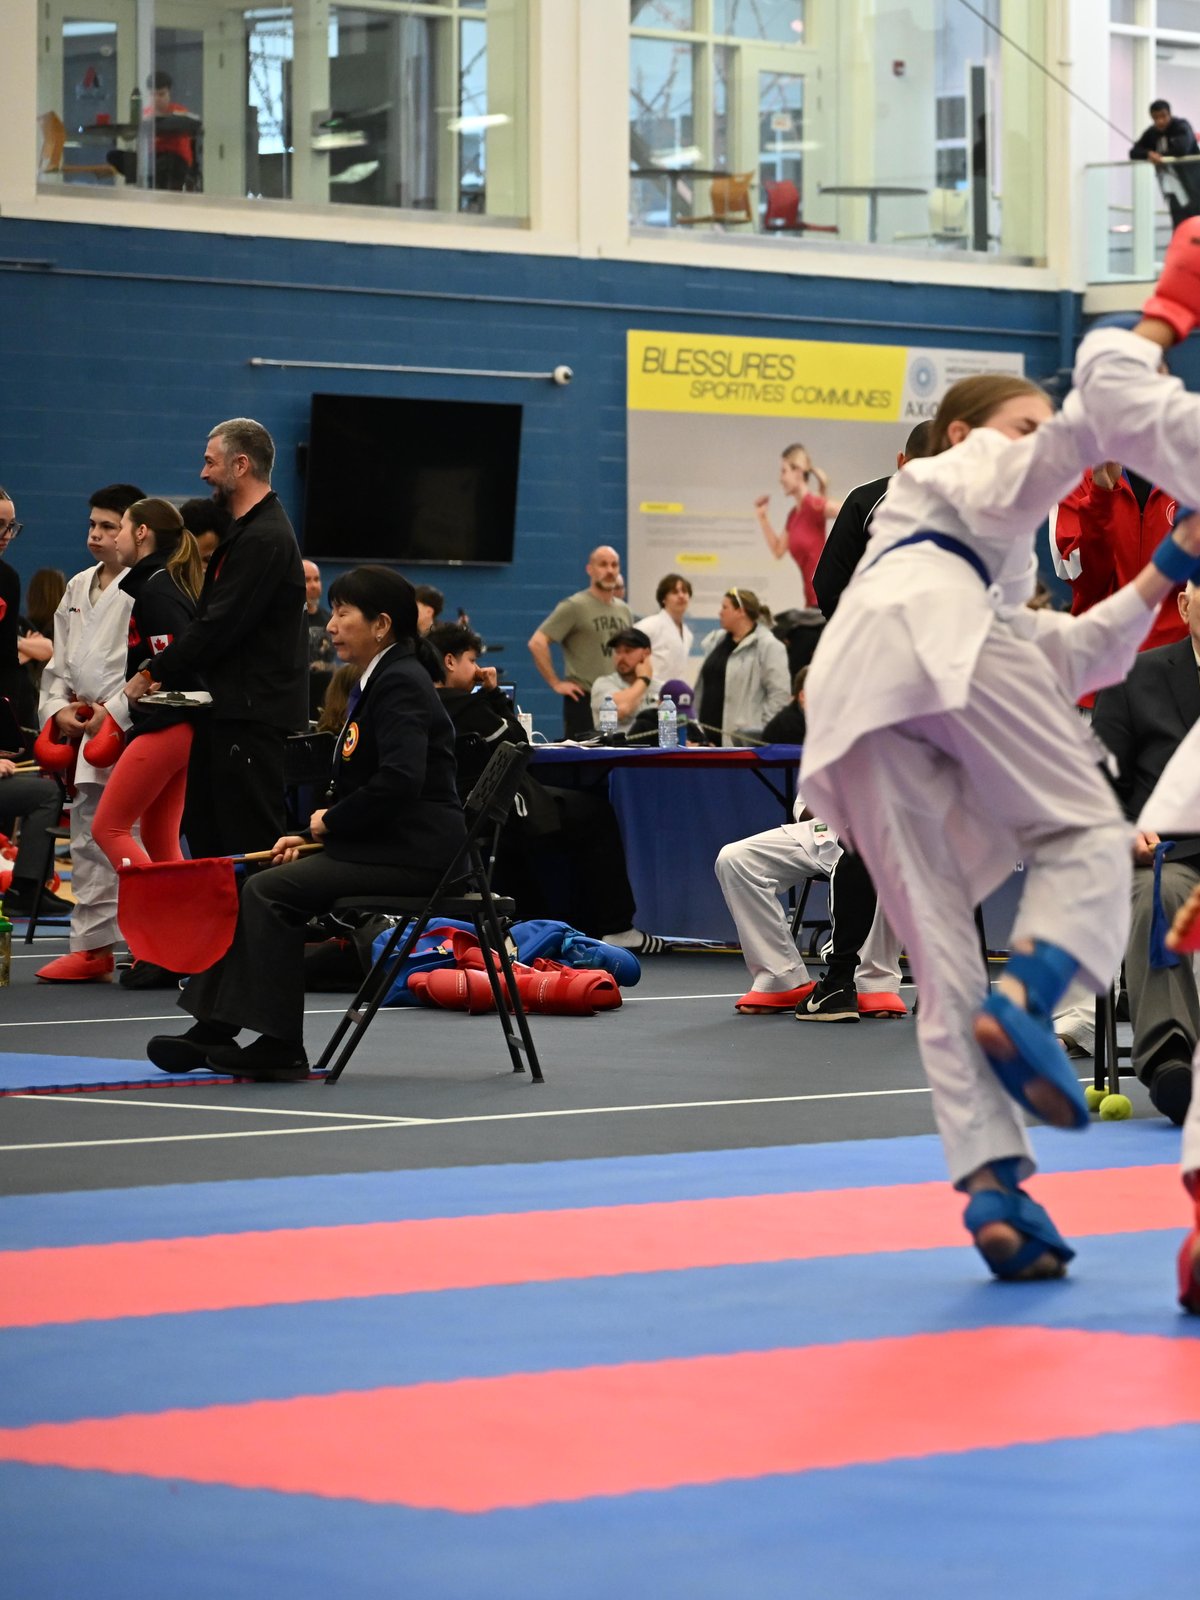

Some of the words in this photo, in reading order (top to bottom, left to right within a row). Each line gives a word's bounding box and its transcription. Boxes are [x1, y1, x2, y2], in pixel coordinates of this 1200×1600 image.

[642, 346, 795, 381] BLESSURES
[689, 380, 786, 403] SPORTIVES
[791, 385, 892, 409] COMMUNES
